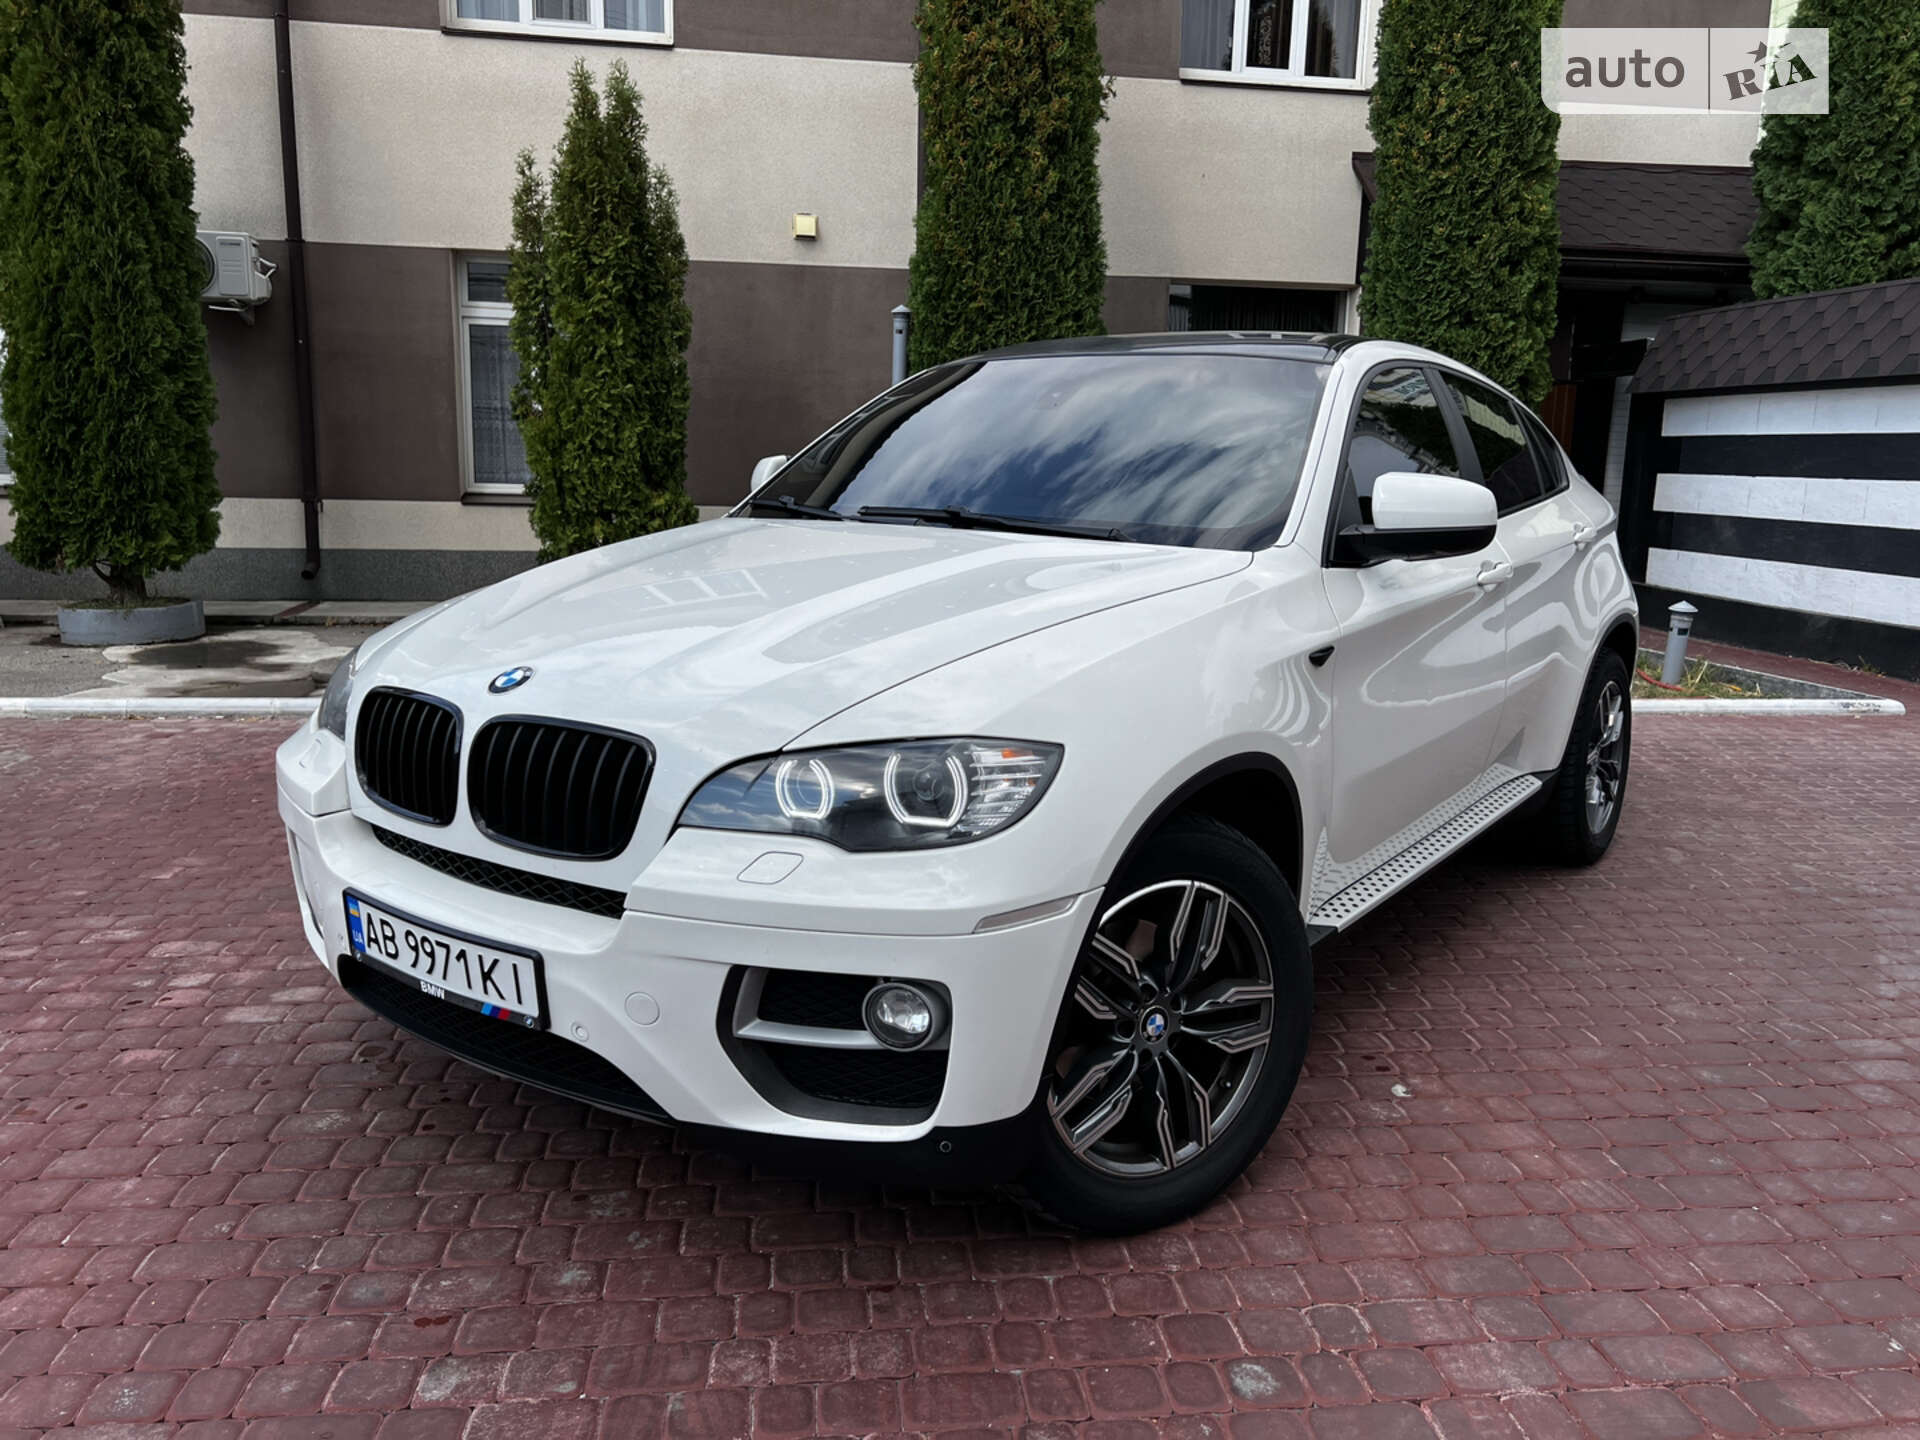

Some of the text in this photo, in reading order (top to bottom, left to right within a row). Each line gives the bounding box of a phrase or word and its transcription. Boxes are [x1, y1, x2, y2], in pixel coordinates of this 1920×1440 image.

[366, 911, 523, 1005] AB 9971 KI
[420, 980, 445, 1000] BMW
